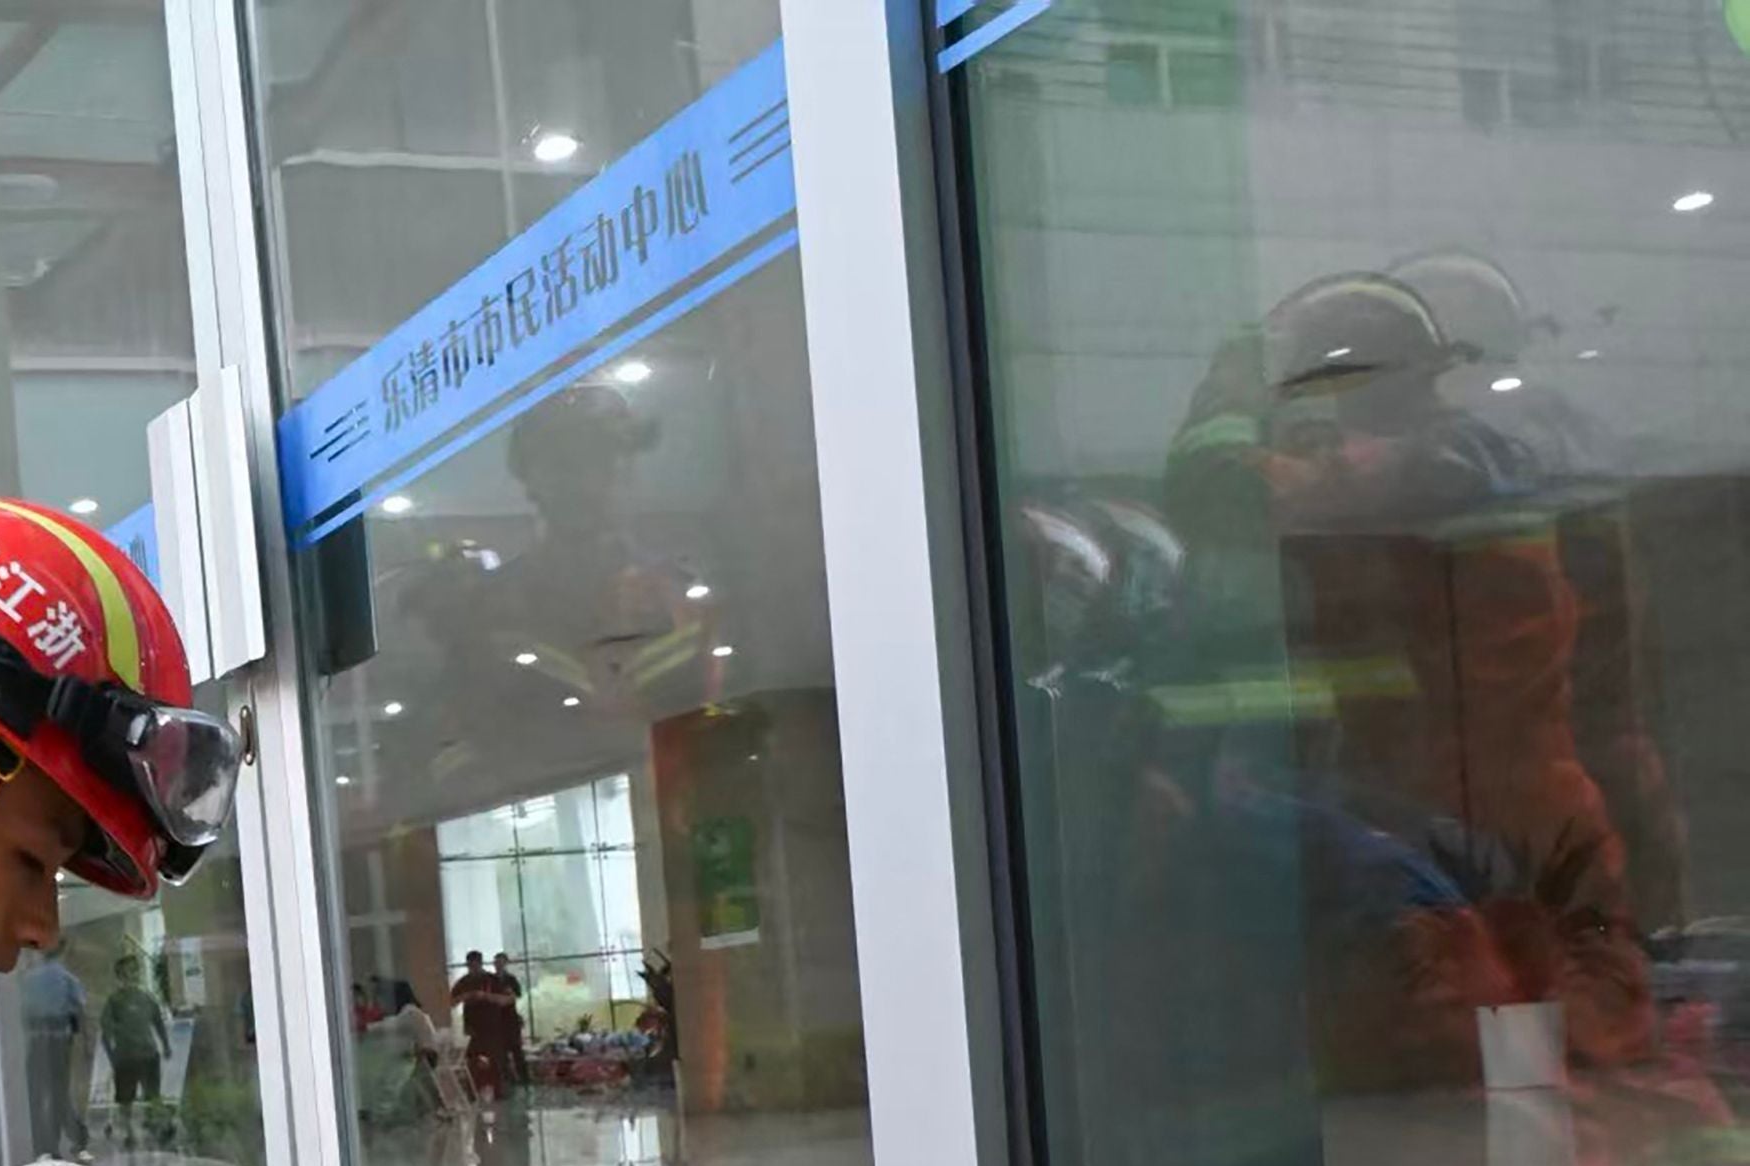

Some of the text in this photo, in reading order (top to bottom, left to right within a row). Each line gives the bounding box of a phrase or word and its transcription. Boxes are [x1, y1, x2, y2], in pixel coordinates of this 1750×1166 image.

[381, 150, 709, 433] 乐清市市民活动中心
